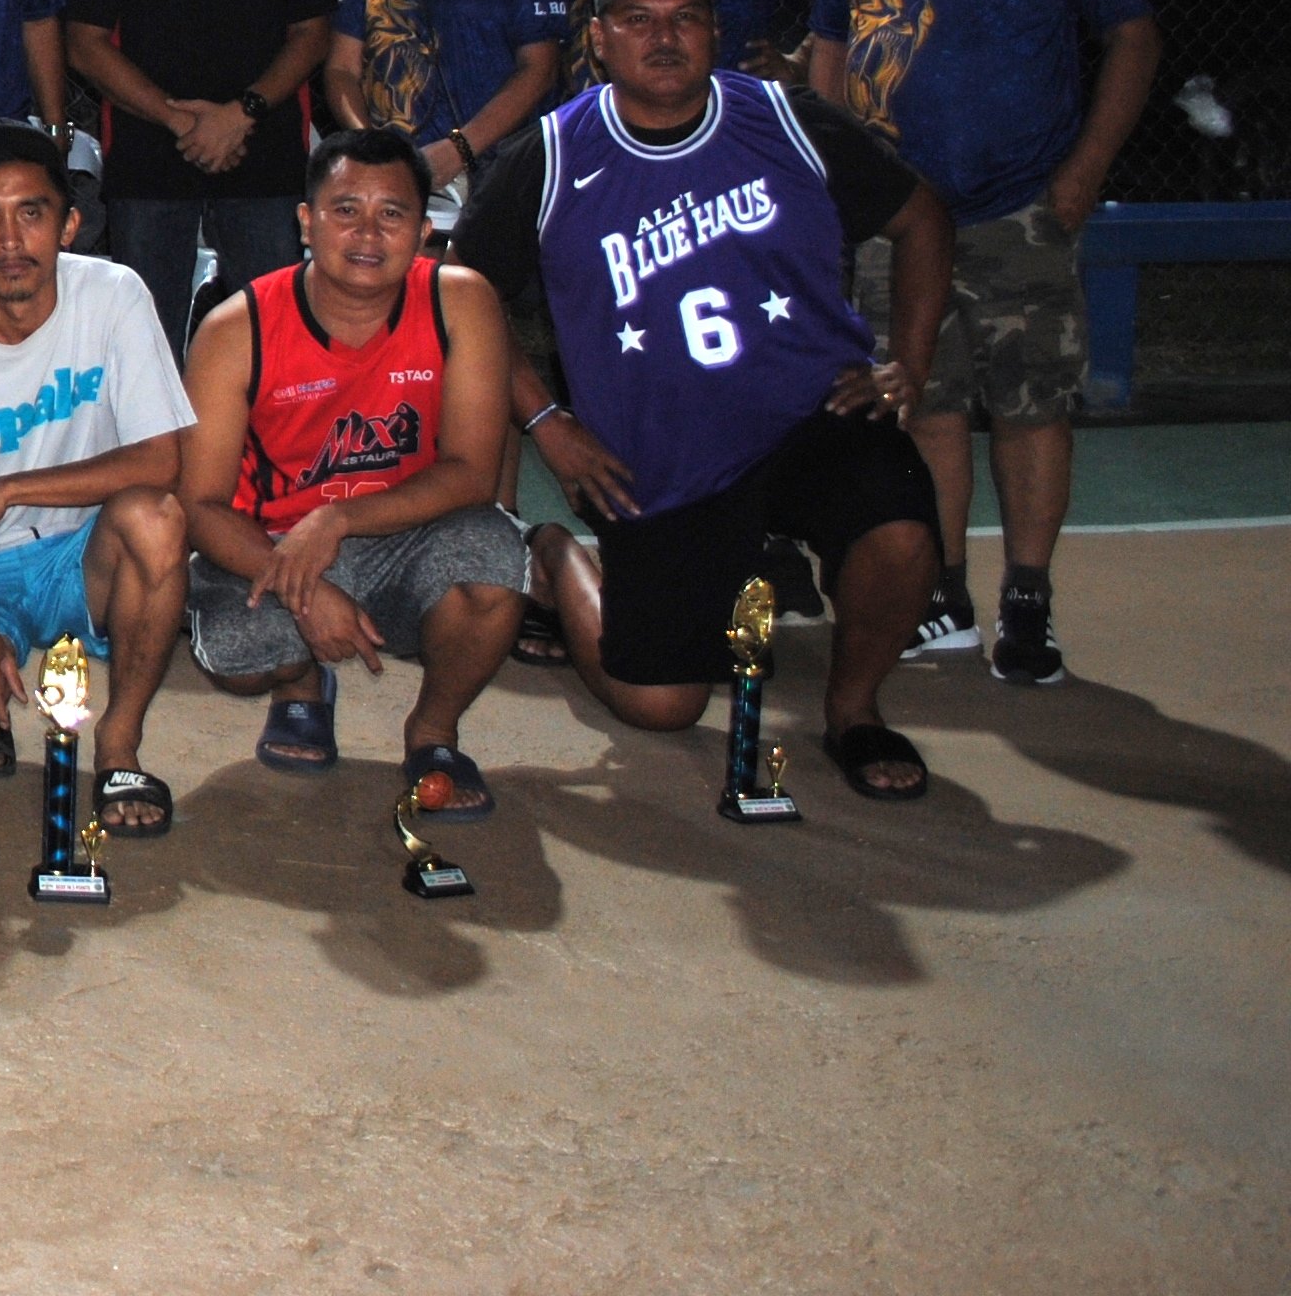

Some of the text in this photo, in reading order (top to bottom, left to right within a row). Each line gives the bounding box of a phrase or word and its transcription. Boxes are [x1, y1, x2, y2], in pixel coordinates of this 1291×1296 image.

[600, 176, 778, 308] BLUE HAUS
[679, 286, 743, 370] 6
[110, 771, 148, 787] NIKE
